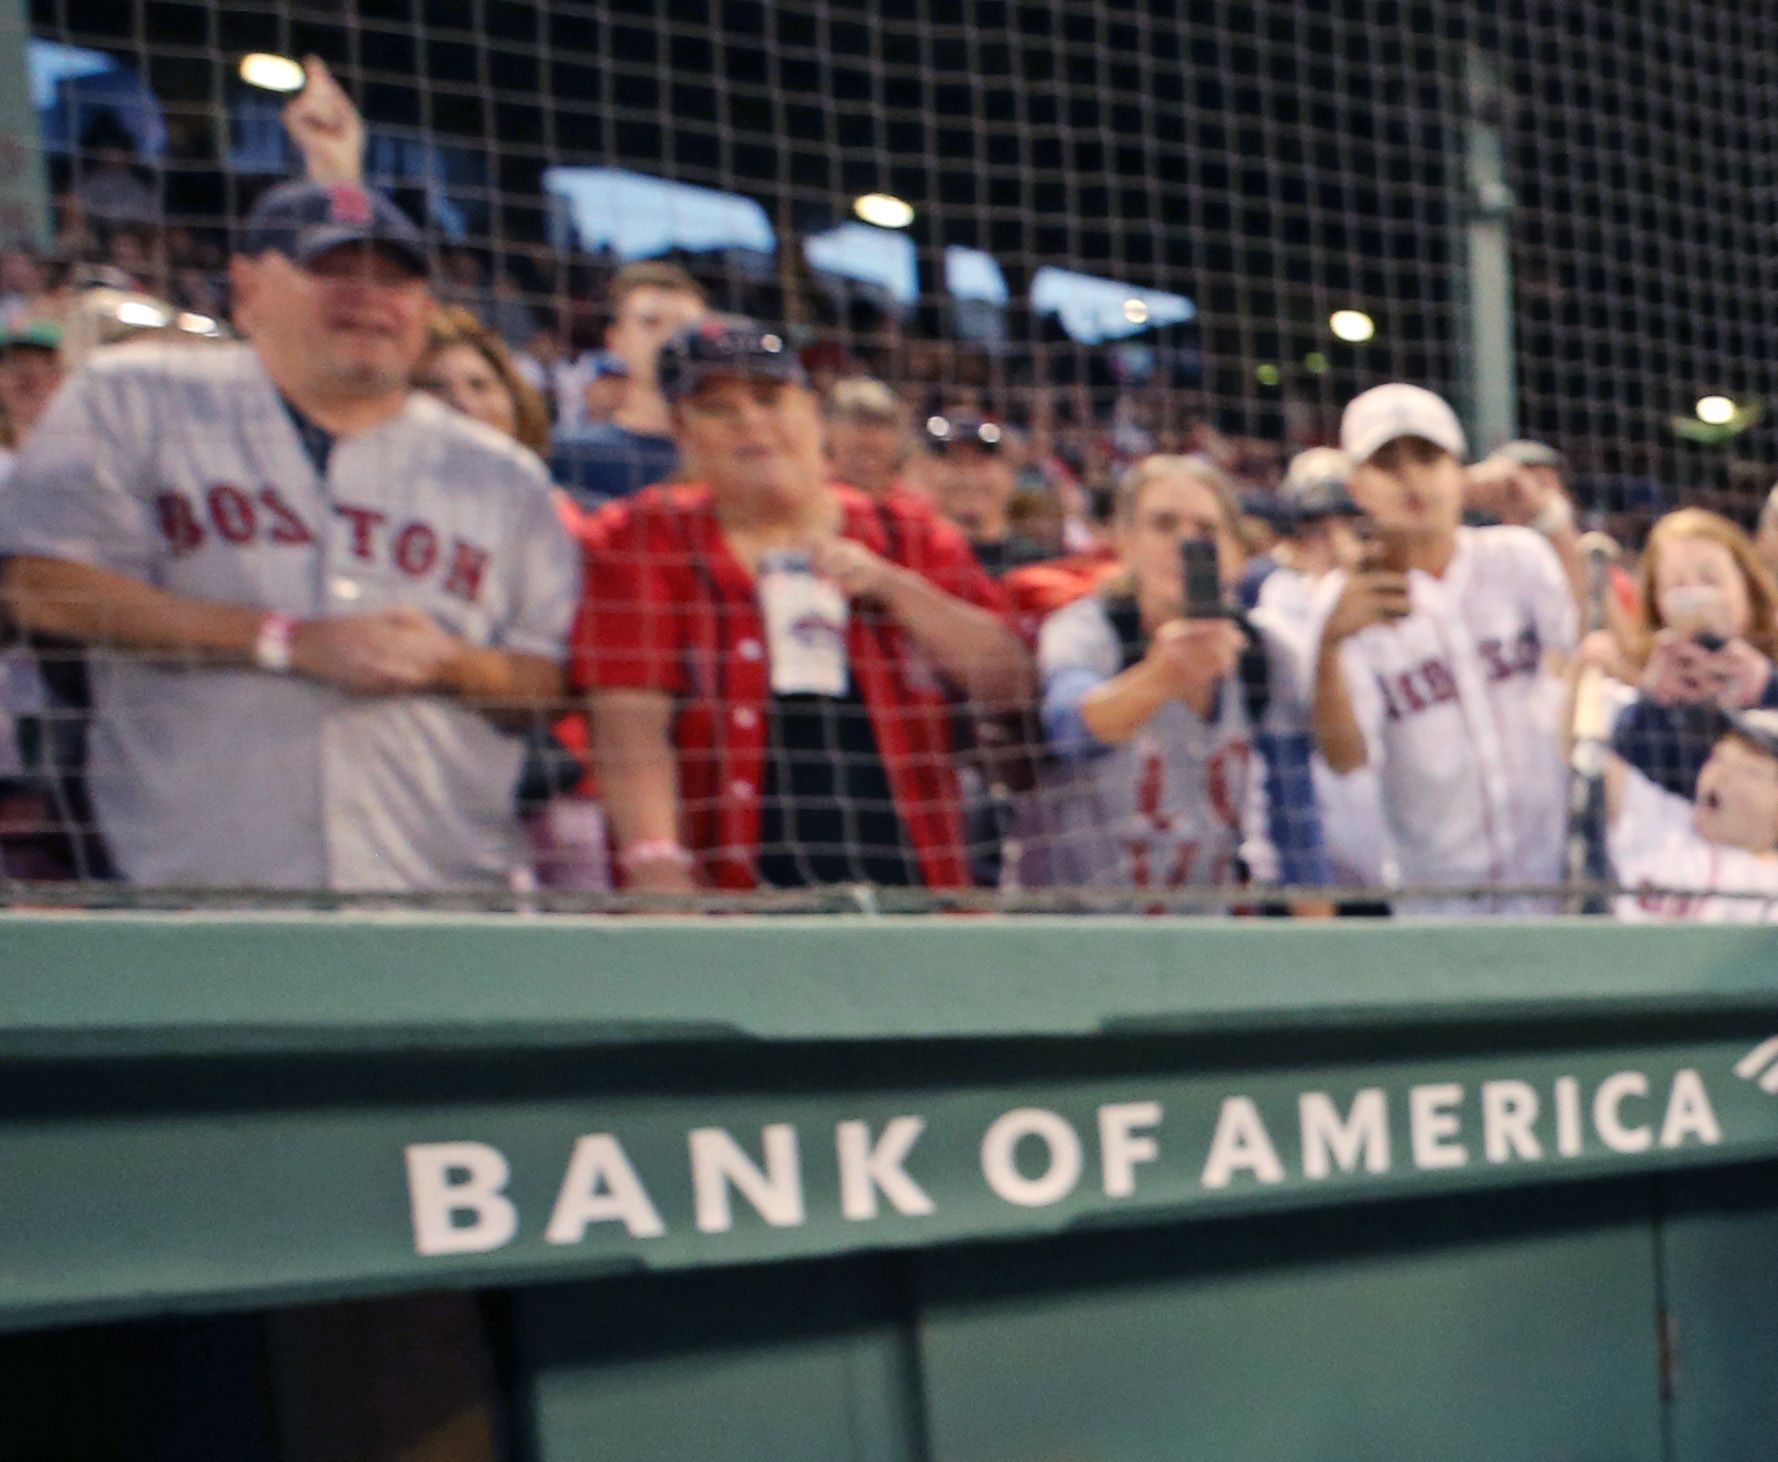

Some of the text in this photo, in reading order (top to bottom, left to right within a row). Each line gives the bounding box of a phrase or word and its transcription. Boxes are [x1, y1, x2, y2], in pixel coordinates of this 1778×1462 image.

[404, 1068, 1722, 1258] BANK OF AMERICA
